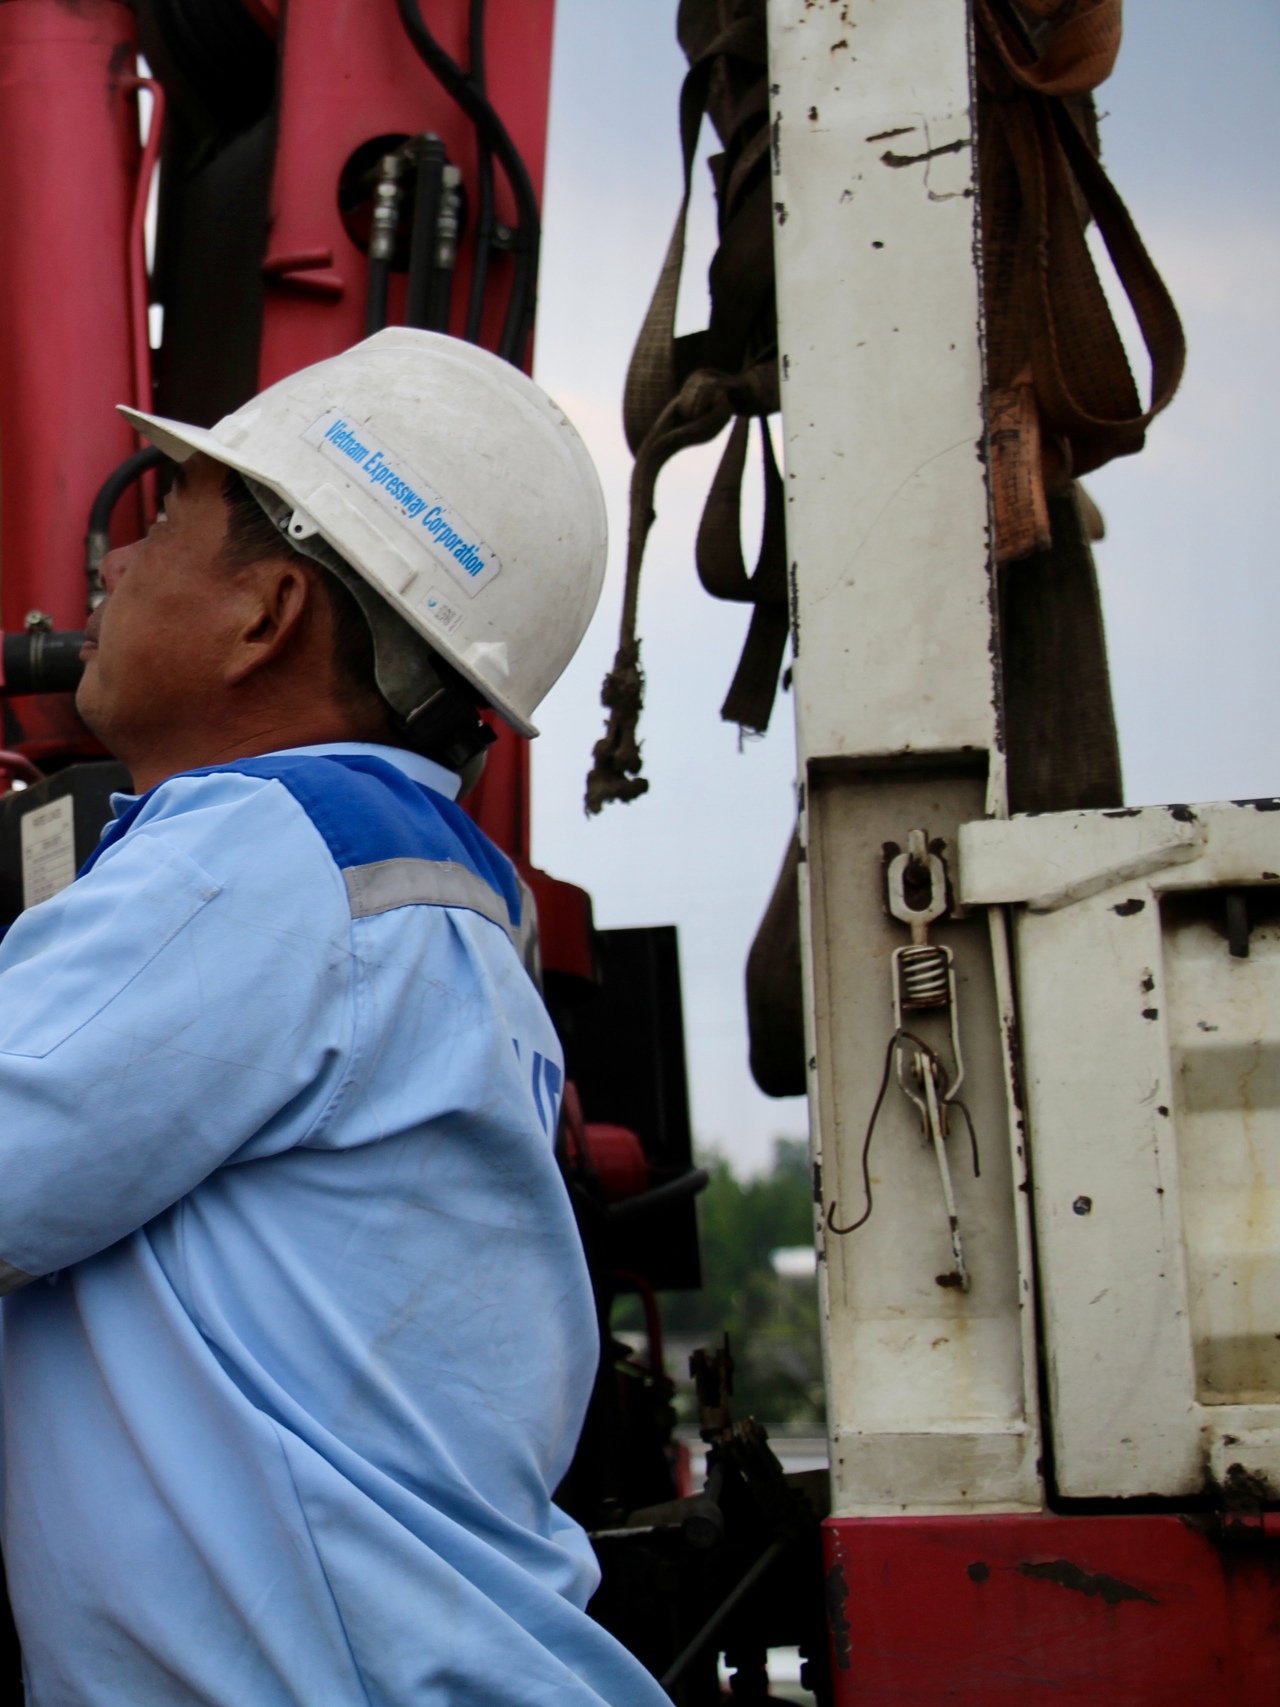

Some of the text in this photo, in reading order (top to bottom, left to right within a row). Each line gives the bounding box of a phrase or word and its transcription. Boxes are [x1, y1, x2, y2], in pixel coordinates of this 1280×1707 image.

[324, 419, 485, 578] Vietnam Expressway Corporation
